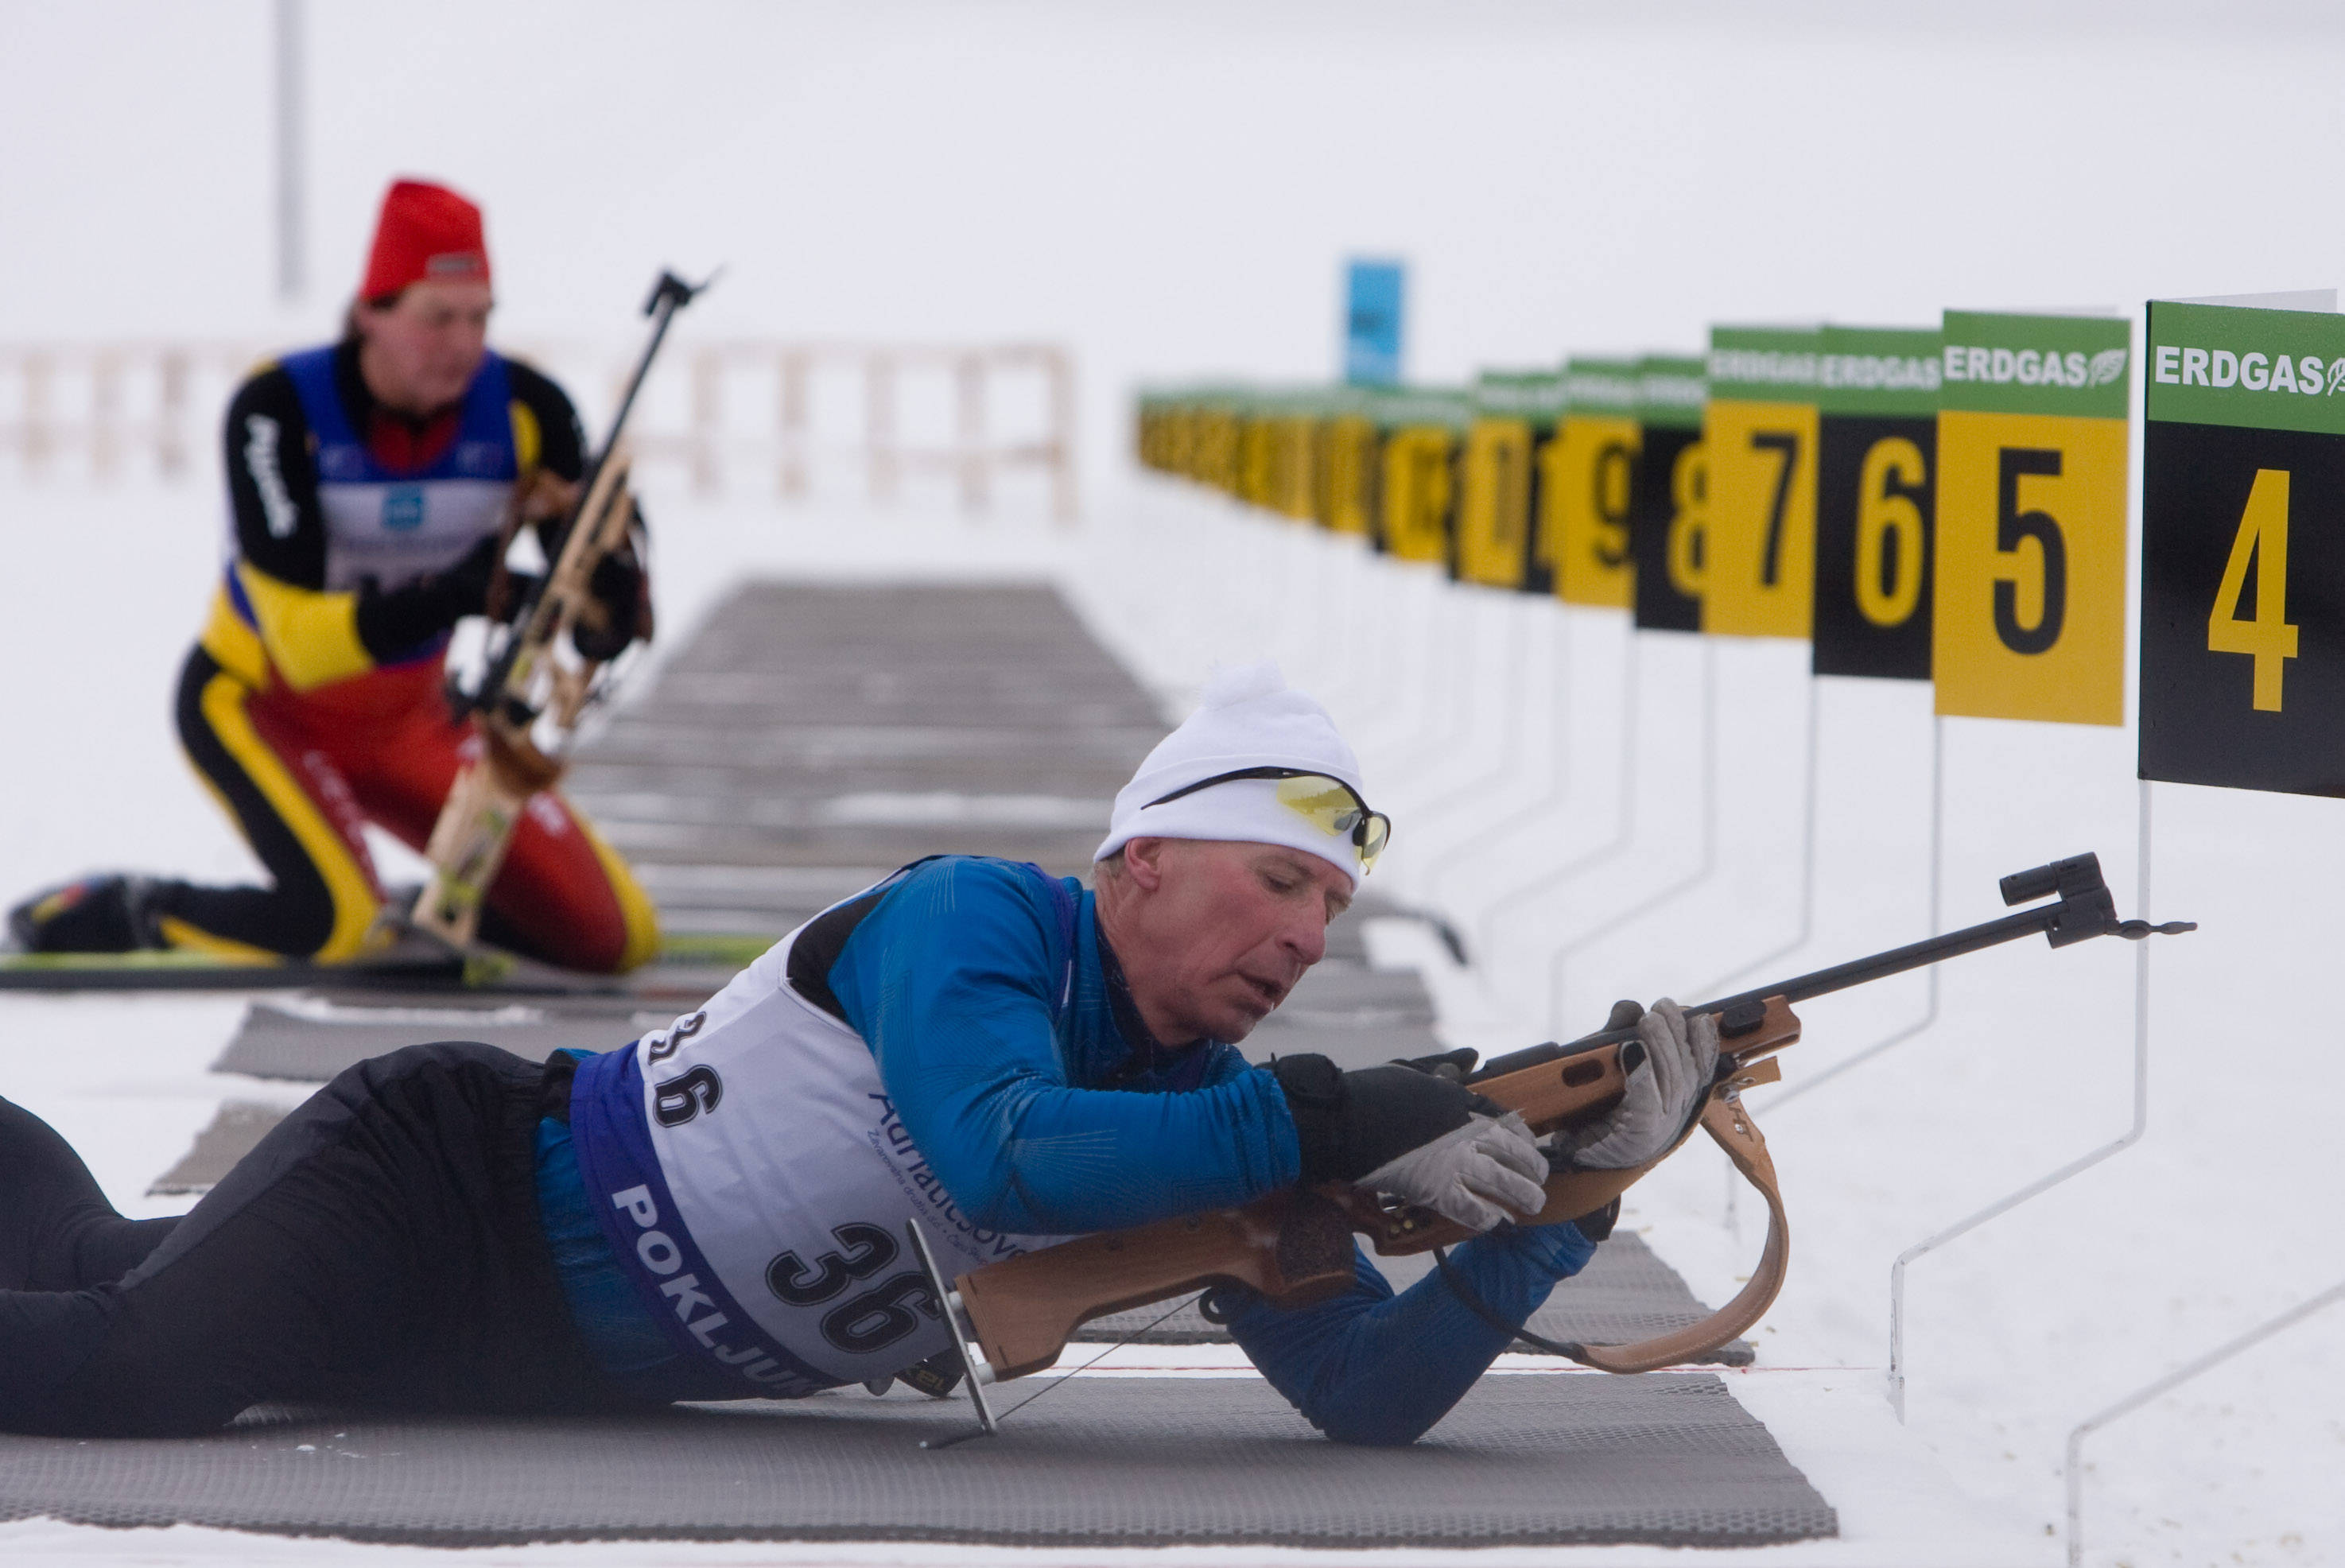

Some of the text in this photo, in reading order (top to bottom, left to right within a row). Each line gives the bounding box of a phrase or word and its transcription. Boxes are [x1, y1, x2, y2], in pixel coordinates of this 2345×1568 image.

[1821, 355, 1942, 391] ERDGAS
[1943, 344, 2089, 388] ERDGAS
[2154, 344, 2325, 396] ERDGAS
[1591, 441, 1635, 570] 9
[1666, 441, 1706, 597] 8
[1749, 429, 1803, 592] 7
[1854, 436, 1926, 627] 6
[1993, 445, 2067, 656] 5
[2207, 468, 2299, 713] 4
[765, 1222, 942, 1354] 36
